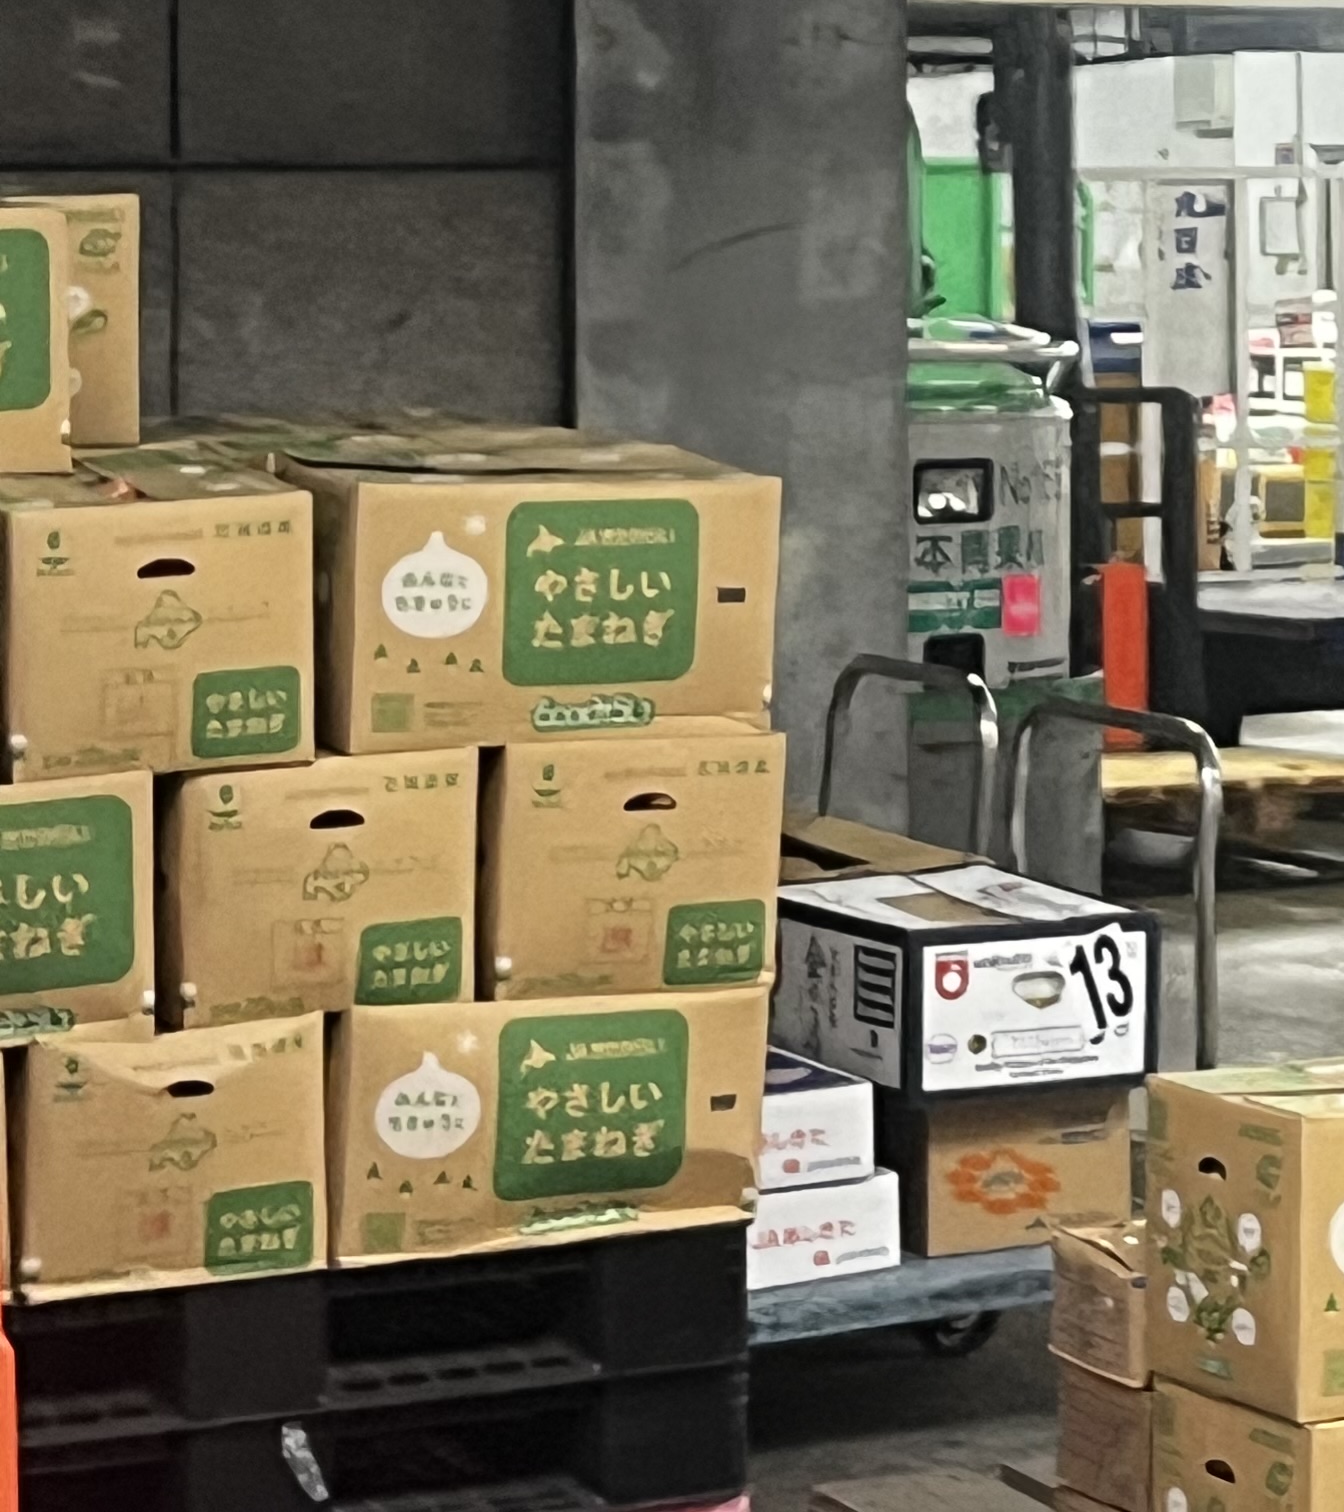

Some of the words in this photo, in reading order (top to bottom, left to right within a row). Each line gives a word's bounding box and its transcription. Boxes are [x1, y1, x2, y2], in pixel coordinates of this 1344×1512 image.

[534, 566, 671, 603] やさしい
[531, 608, 675, 650] たまねぎ
[0, 872, 90, 910] しい
[1069, 934, 1134, 1030] 13
[524, 1080, 664, 1120] やさしい
[520, 1118, 666, 1165] たまねぎ
